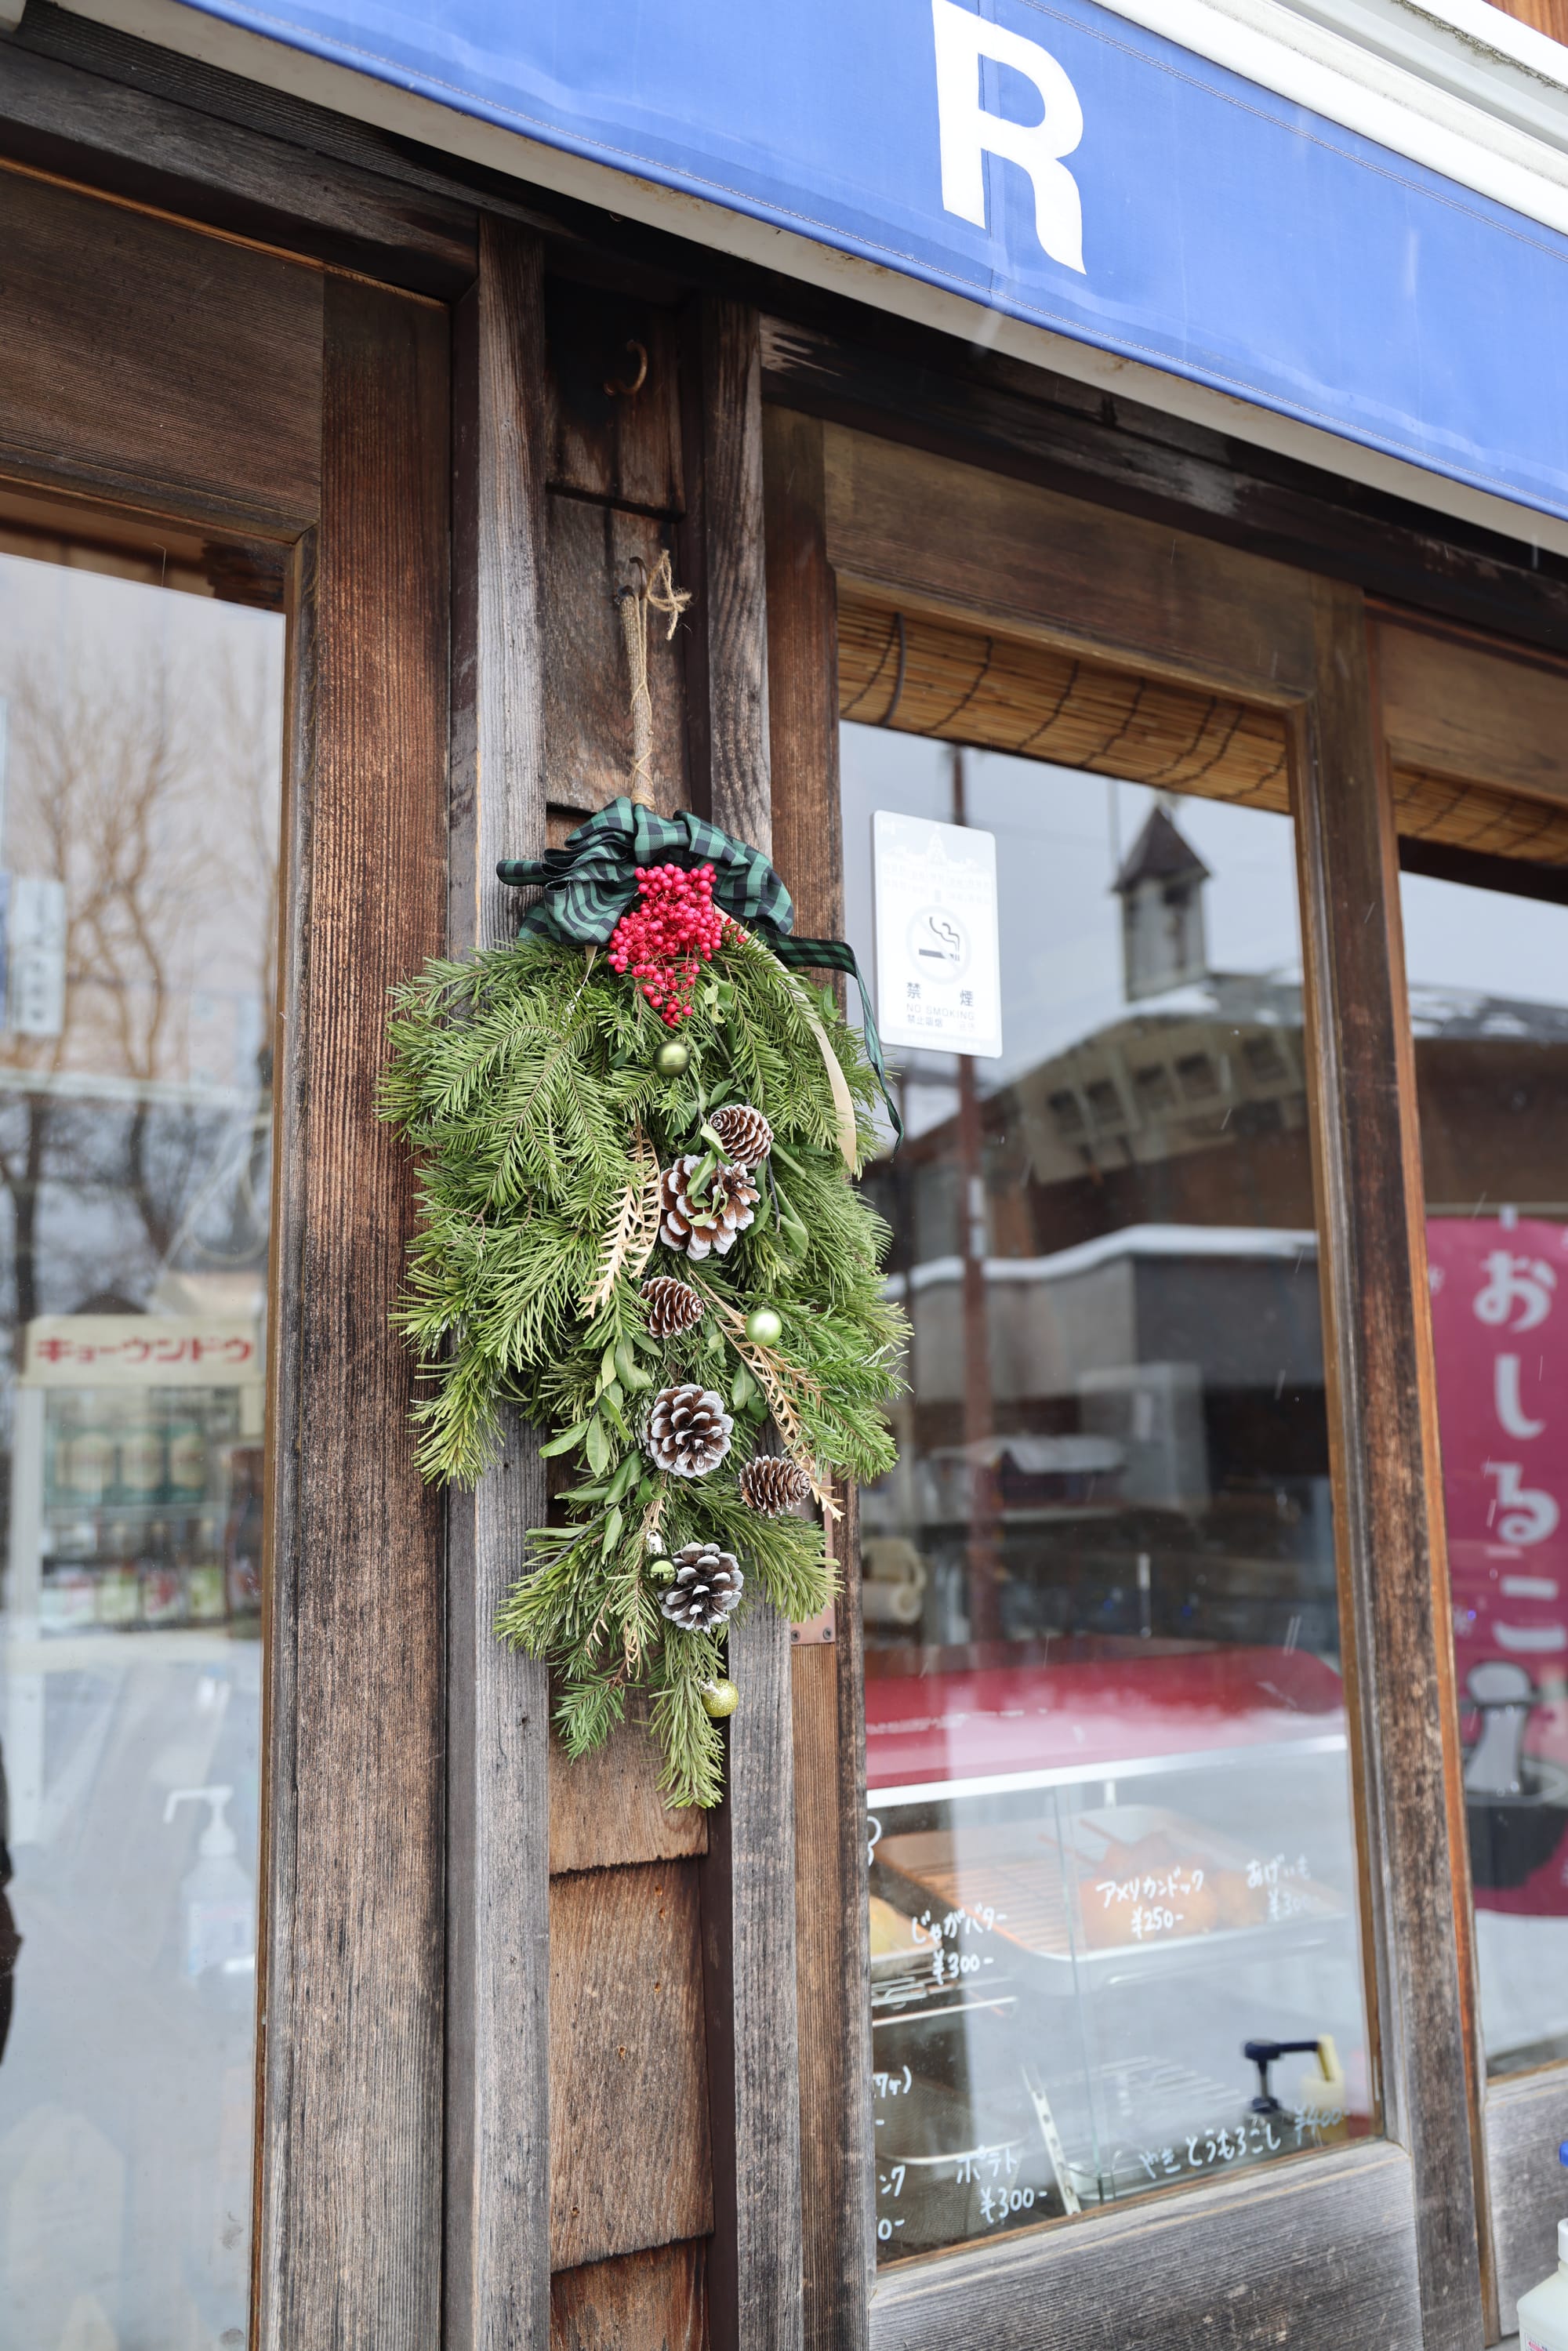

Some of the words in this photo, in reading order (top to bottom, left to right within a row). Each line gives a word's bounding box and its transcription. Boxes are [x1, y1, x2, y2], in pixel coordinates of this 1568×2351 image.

[931, 0, 1087, 276] R
[906, 1003, 922, 1014] NO
[926, 1005, 975, 1021] SMOKING
[1472, 1248, 1566, 1653] おしるこ
[1095, 1866, 1205, 1908] アメリカンドック
[956, 2144, 1018, 2185] ポテト
